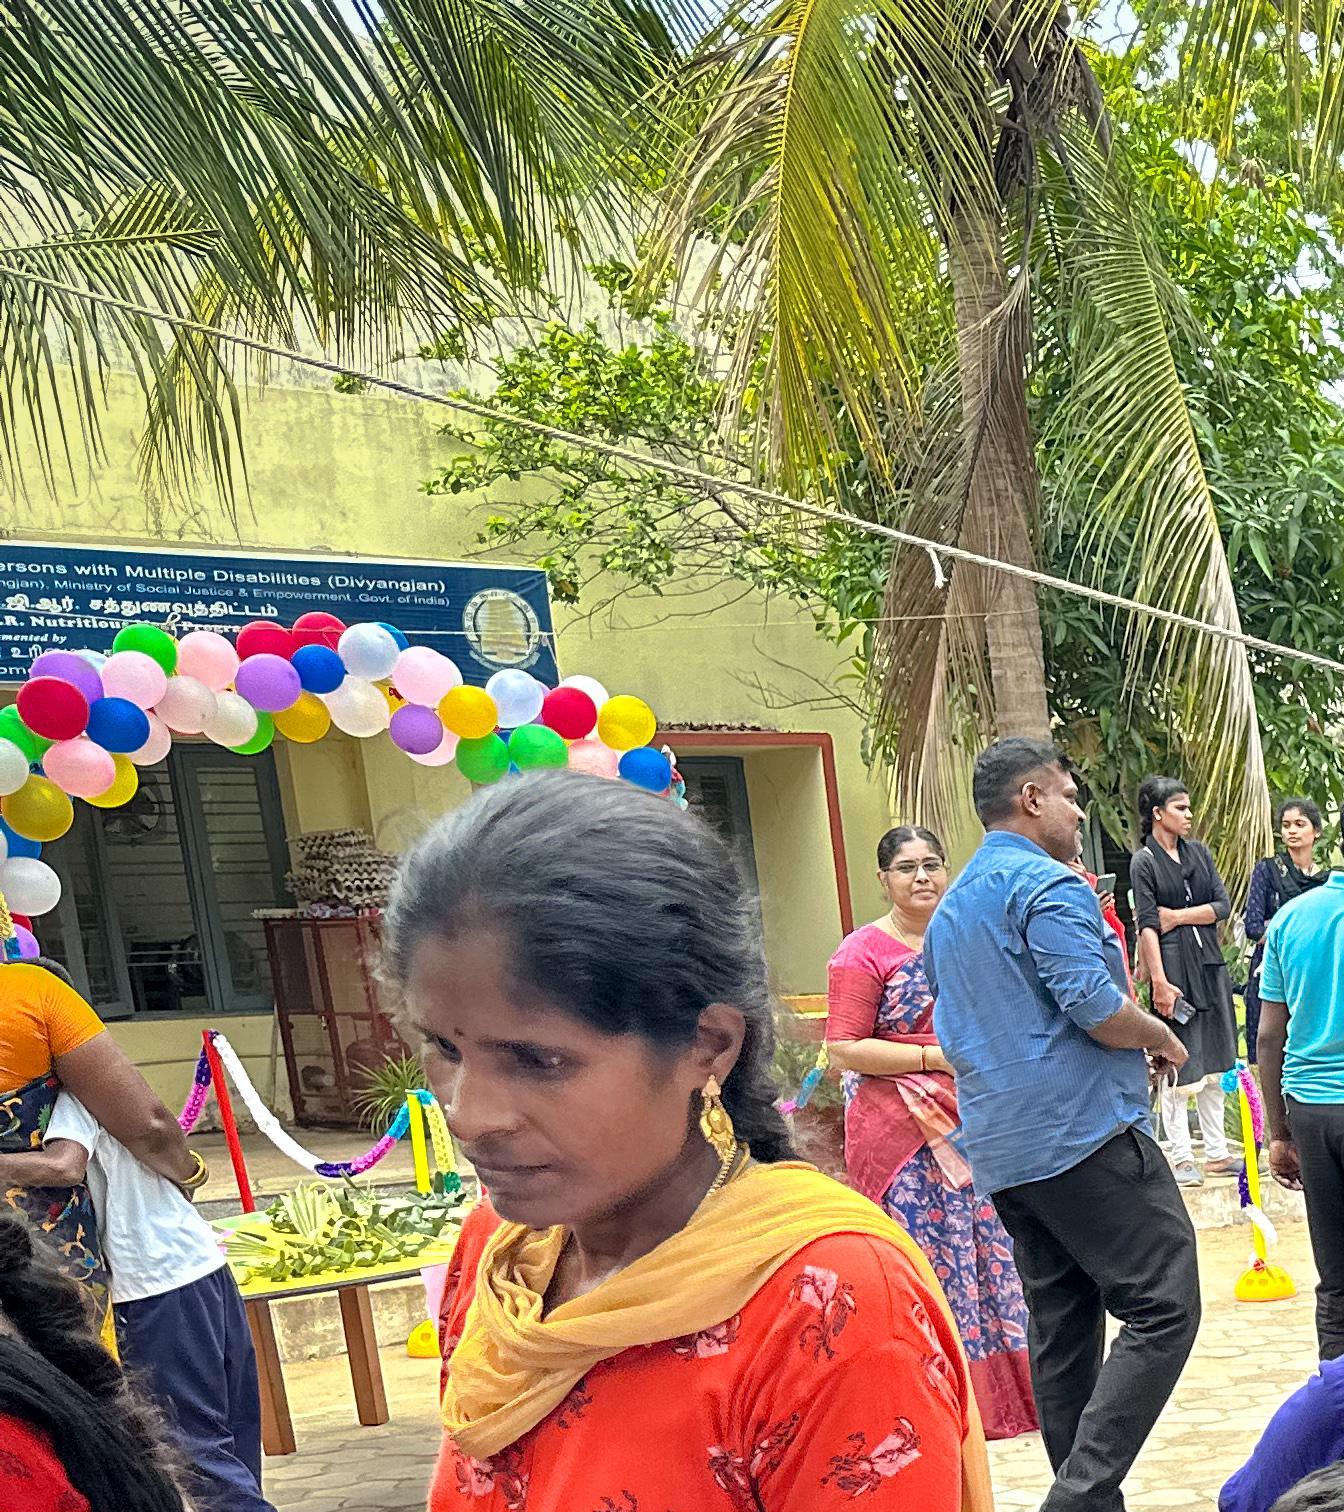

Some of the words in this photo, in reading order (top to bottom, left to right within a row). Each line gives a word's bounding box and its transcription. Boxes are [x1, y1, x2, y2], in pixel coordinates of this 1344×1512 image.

[74, 564, 118, 577] with
[125, 565, 207, 583] Multiple
[213, 569, 321, 587] Disabilities
[327, 574, 446, 595] (Divyangjan)
[54, 580, 112, 593] Ministry
[116, 581, 131, 593] of
[136, 583, 180, 595] Social
[183, 585, 234, 597] Justice
[238, 587, 249, 598] &
[253, 588, 351, 603] Empowerment
[397, 595, 411, 605] of
[413, 595, 450, 608] India)
[52, 633, 67, 644] by
